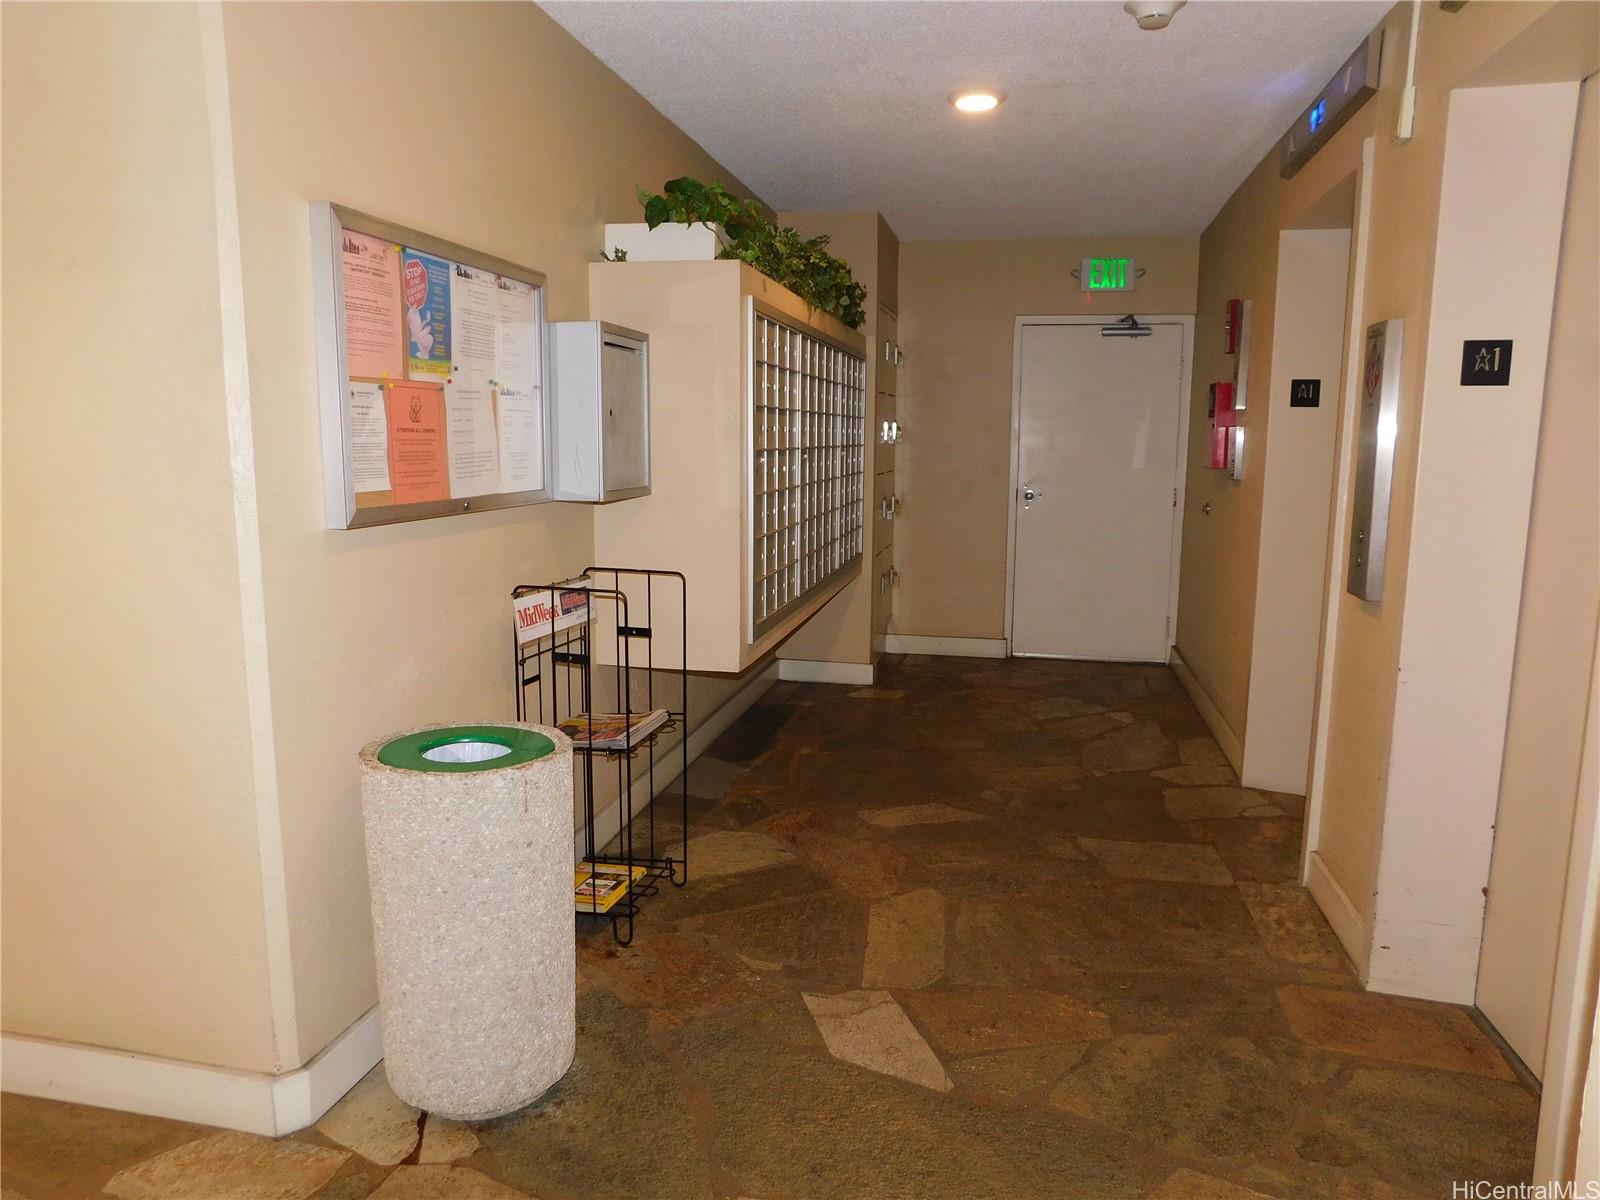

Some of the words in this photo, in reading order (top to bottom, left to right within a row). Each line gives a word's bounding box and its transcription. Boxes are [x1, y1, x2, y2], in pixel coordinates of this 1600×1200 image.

[406, 267, 422, 279] STOP
[1090, 258, 1128, 288] EXIT
[517, 602, 560, 629] MidWeek
